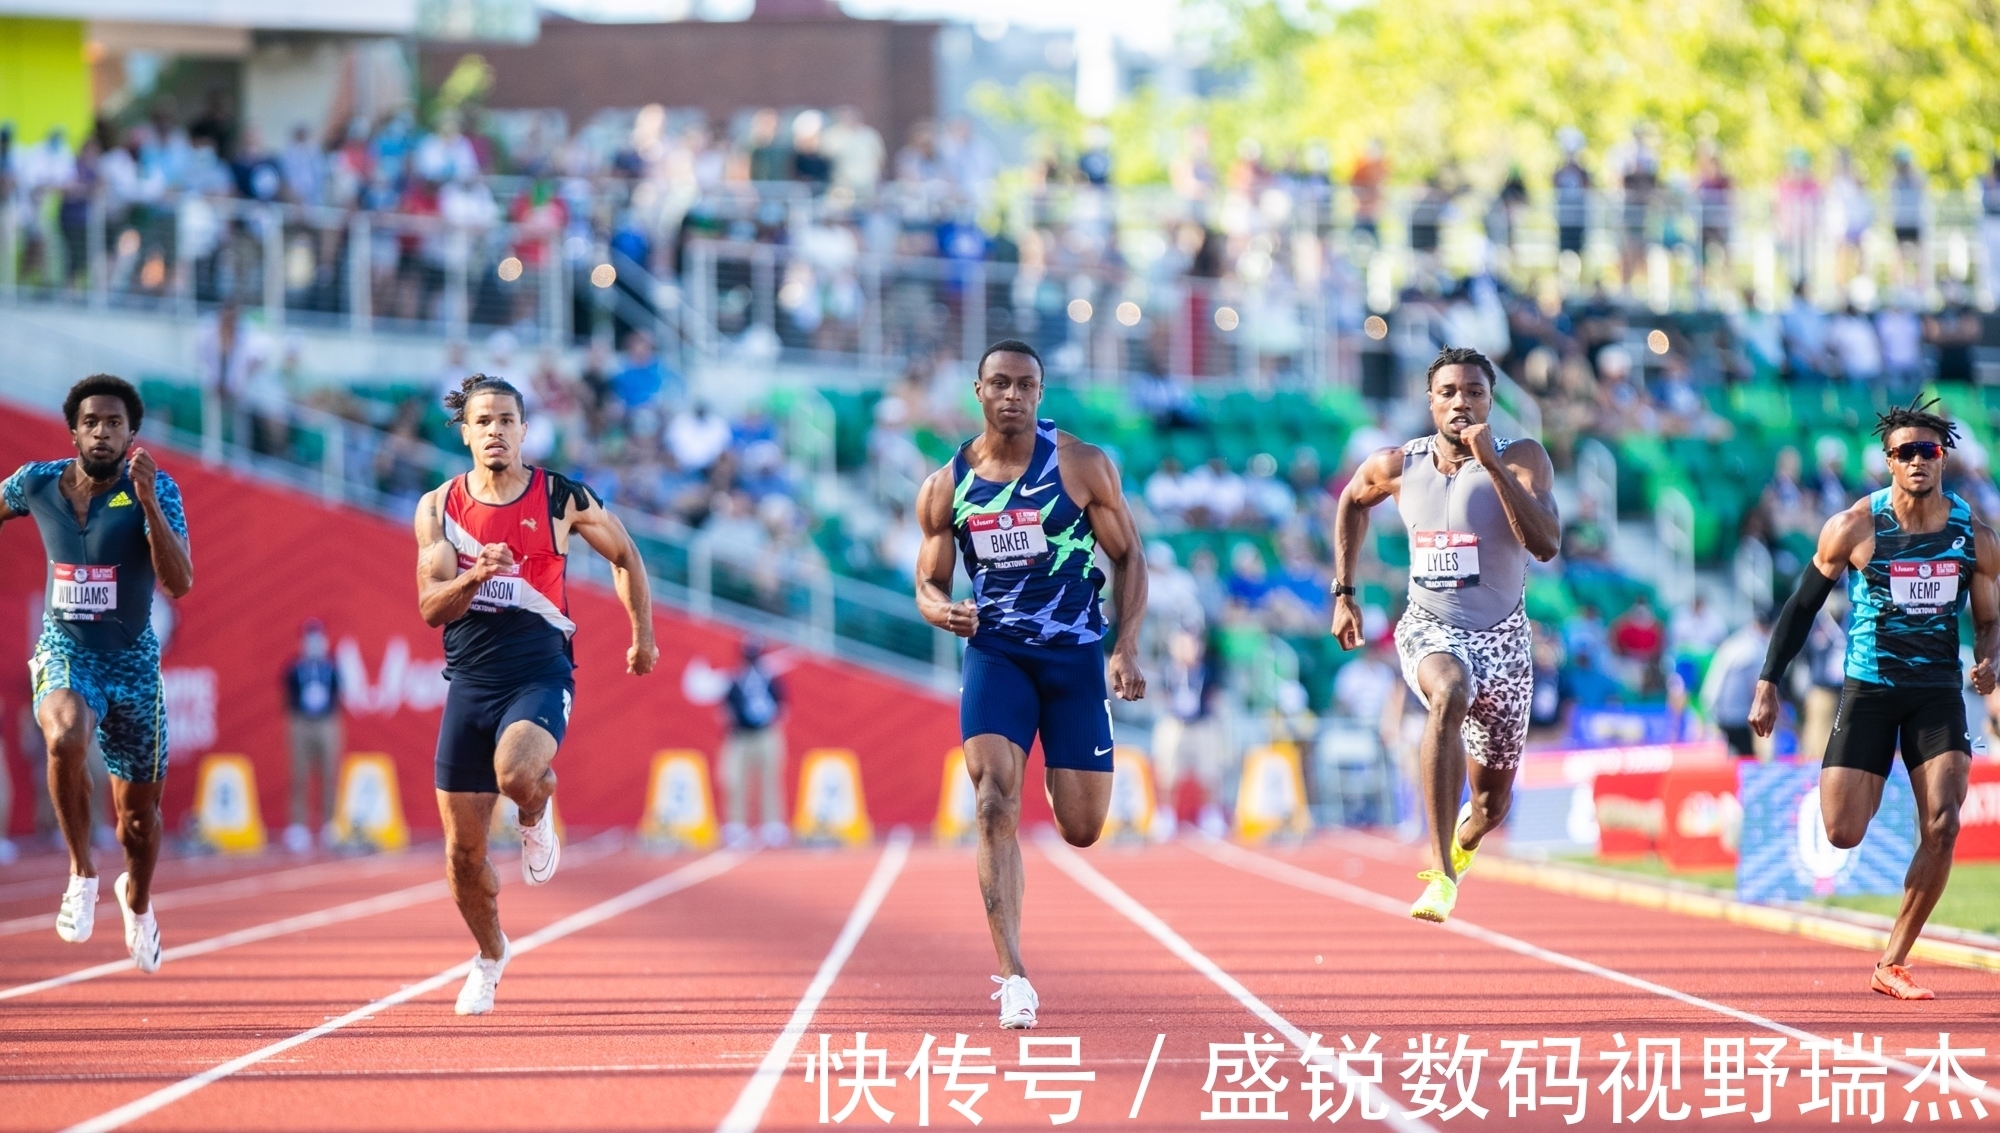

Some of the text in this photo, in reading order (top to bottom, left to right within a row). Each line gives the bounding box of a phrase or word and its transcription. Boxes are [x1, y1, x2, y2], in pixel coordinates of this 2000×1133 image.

[990, 531, 1030, 553] BAKER
[1427, 552, 1459, 572] LYLES
[58, 586, 109, 606] WILLIAMS
[476, 580, 514, 601] INSON
[1909, 581, 1941, 600] KEMP
